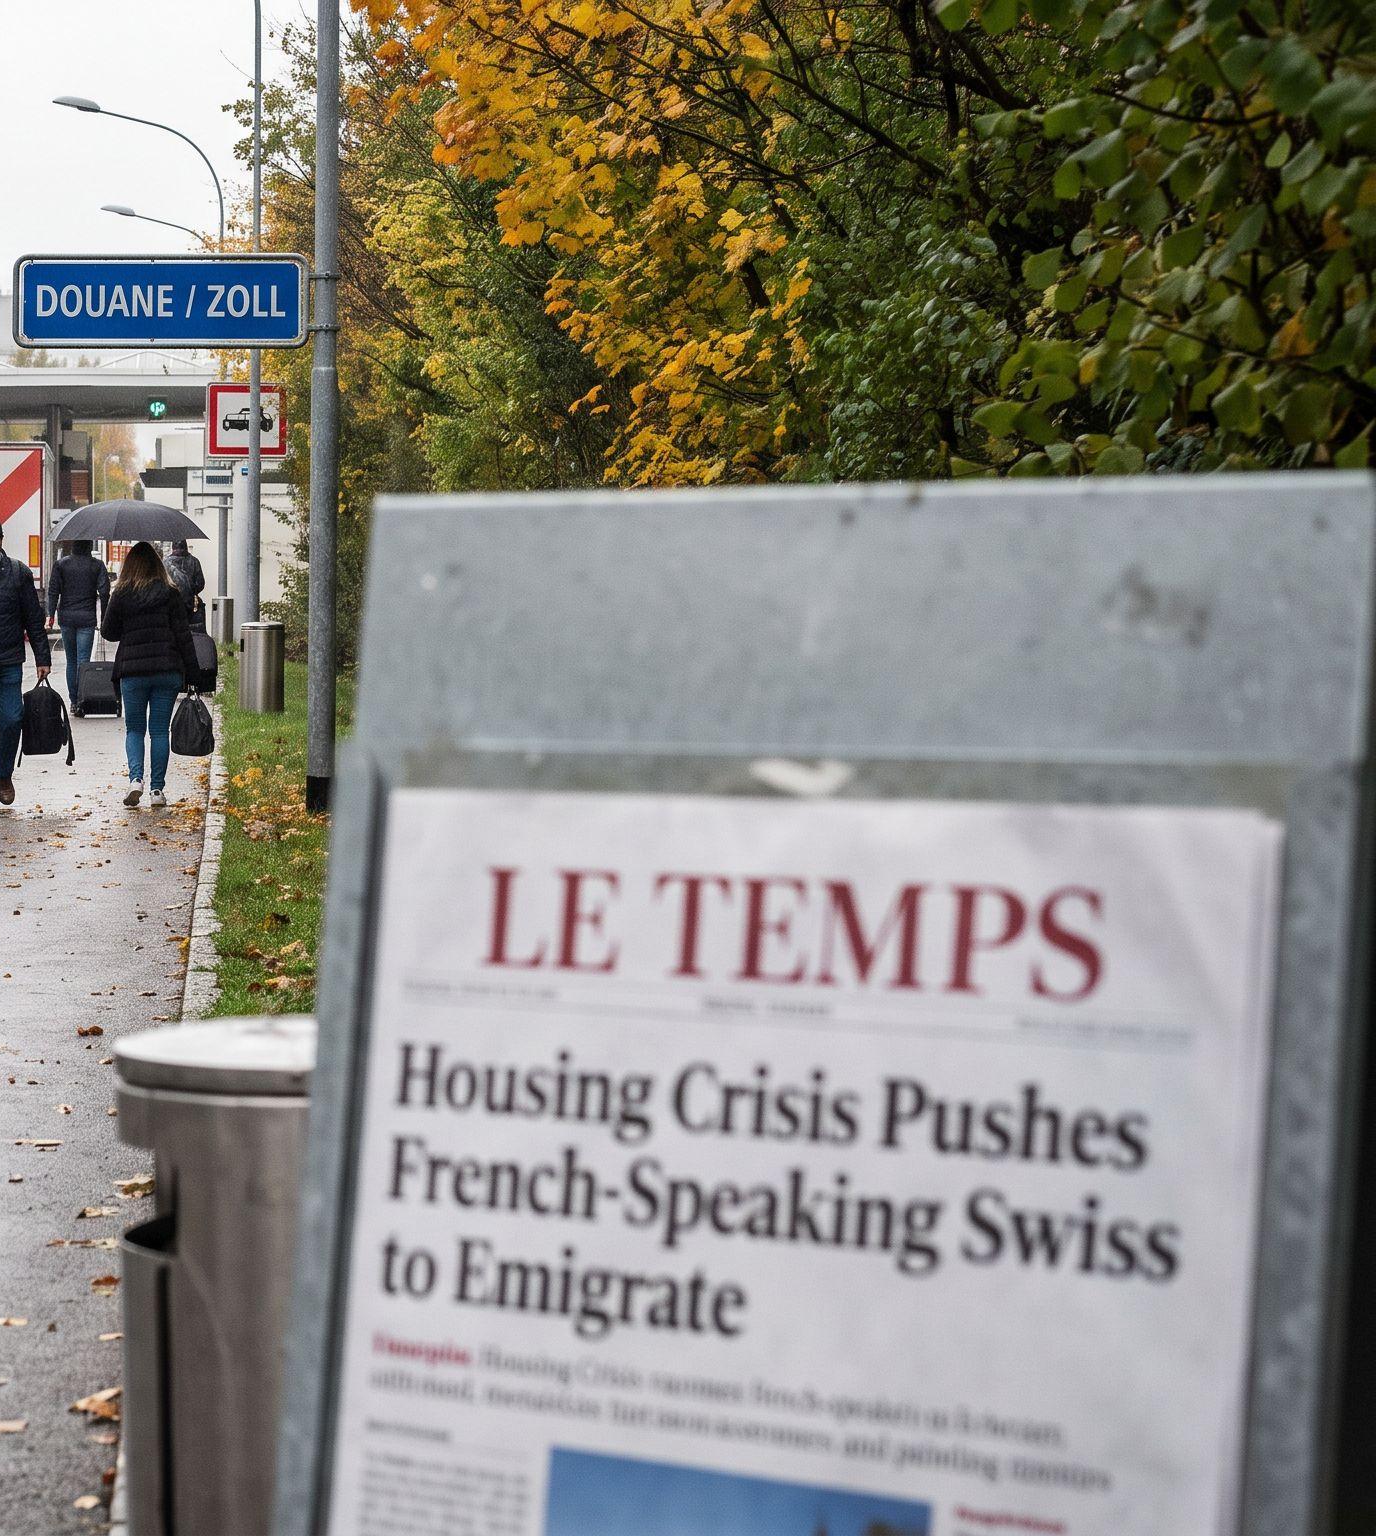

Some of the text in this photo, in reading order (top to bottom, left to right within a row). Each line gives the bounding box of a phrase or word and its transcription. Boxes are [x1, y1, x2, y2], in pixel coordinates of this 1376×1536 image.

[36, 284, 286, 318] DOUANE / ZOLL
[480, 866, 1106, 1005] LE TEMPS
[395, 1041, 1150, 1173] Housing Crisis Pushes
[388, 1134, 1183, 1285] French-Speaking Swiss
[381, 1236, 748, 1341] to Emigrate
